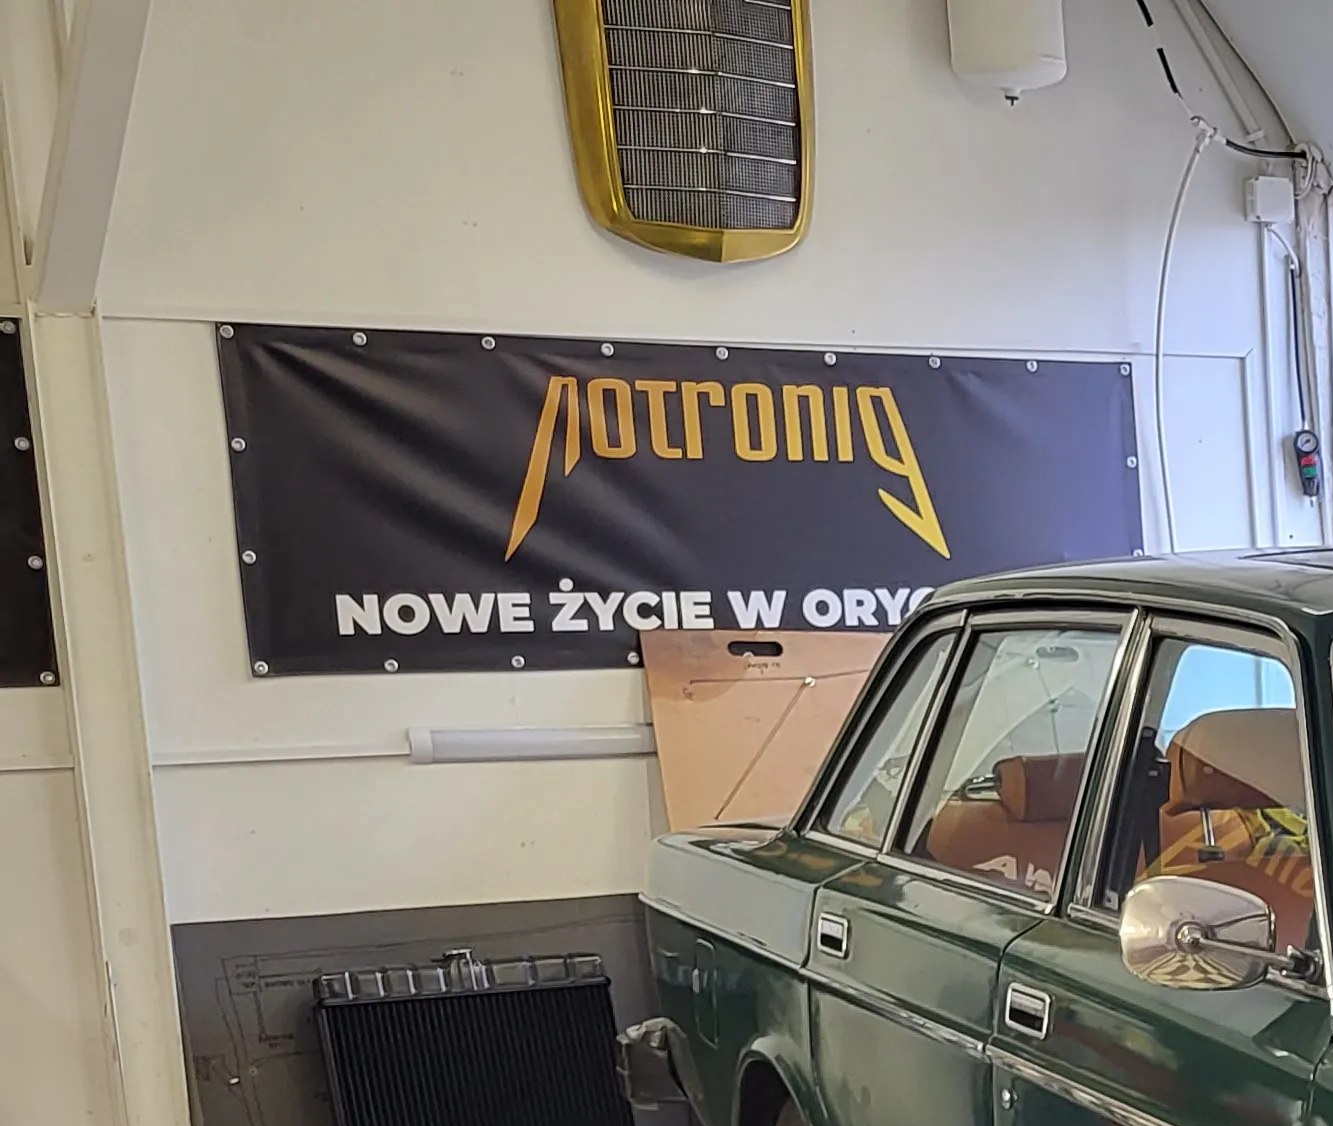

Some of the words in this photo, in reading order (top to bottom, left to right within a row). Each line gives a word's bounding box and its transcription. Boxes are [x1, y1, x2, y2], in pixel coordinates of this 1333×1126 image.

[335, 592, 535, 636] NOWE
[549, 577, 714, 632] ŻYCIE
[727, 589, 787, 629] W
